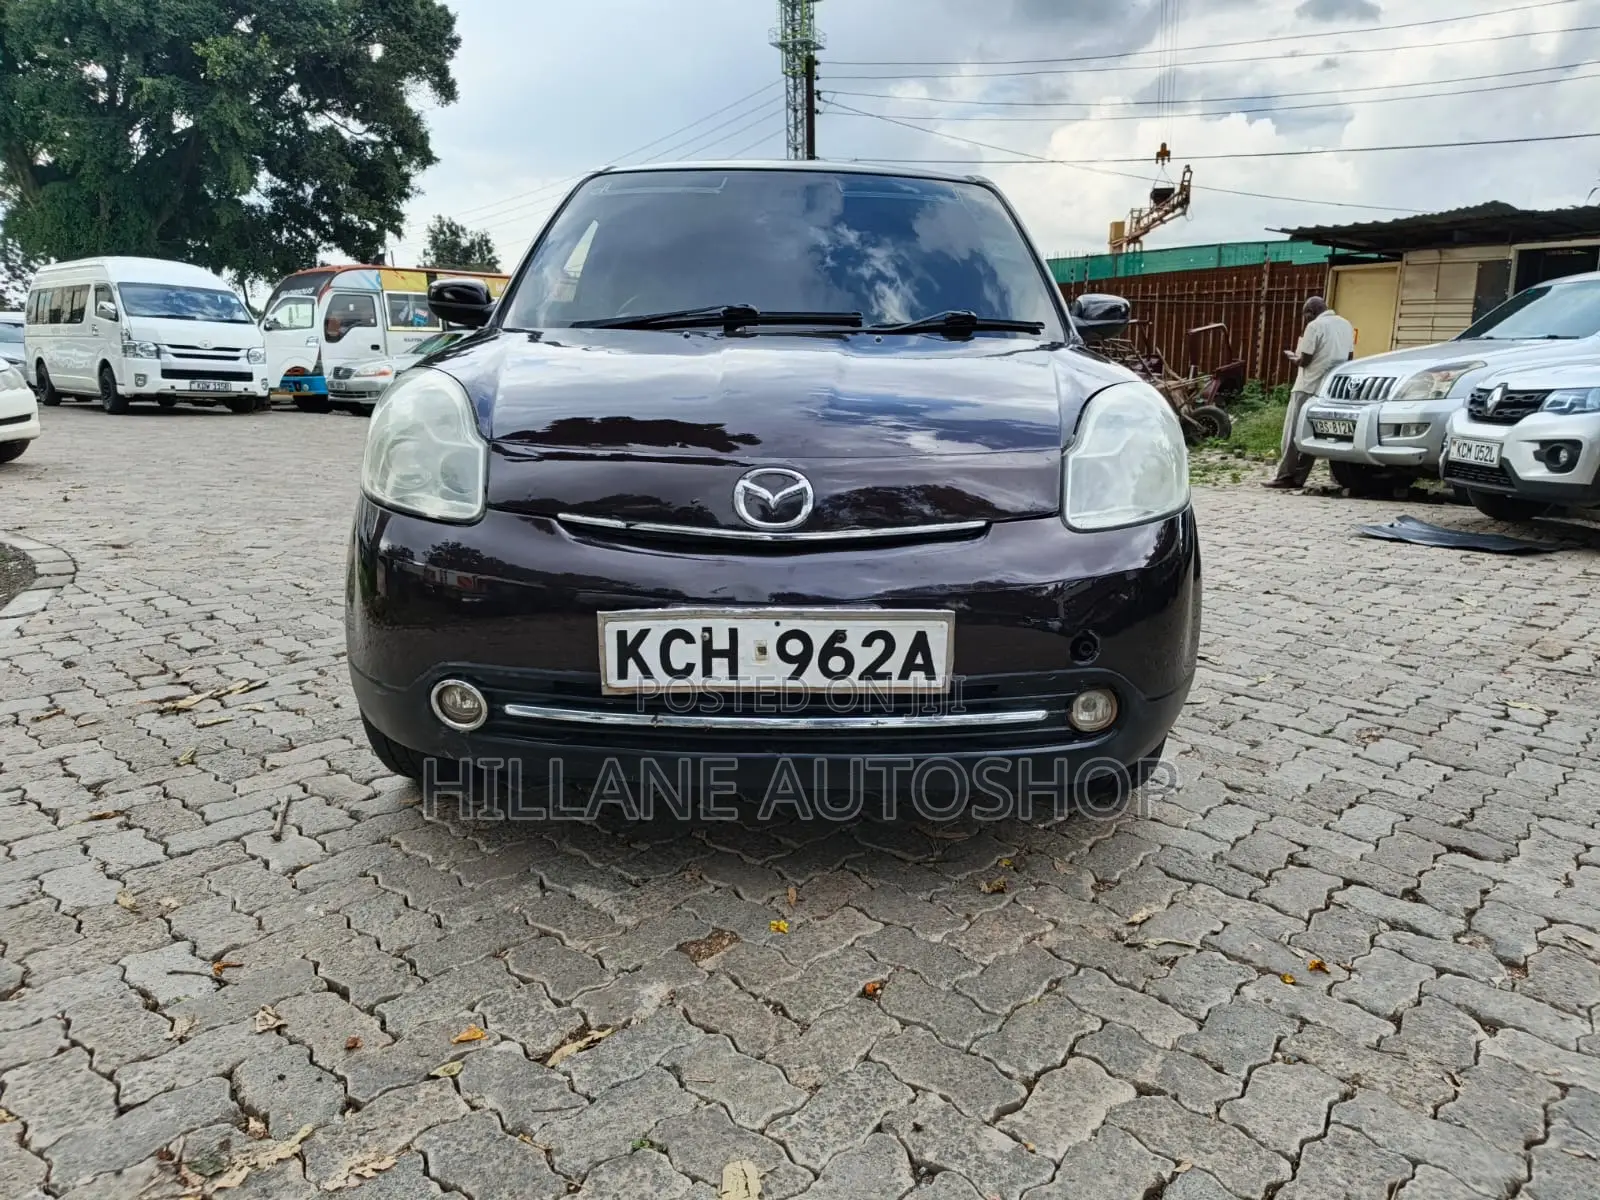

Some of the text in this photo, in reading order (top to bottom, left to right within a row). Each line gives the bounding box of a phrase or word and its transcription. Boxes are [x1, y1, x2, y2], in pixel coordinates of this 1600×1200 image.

[1314, 420, 1330, 433] KBS
[1457, 441, 1495, 463] KCM 052L
[616, 627, 937, 682] KCH 962A
